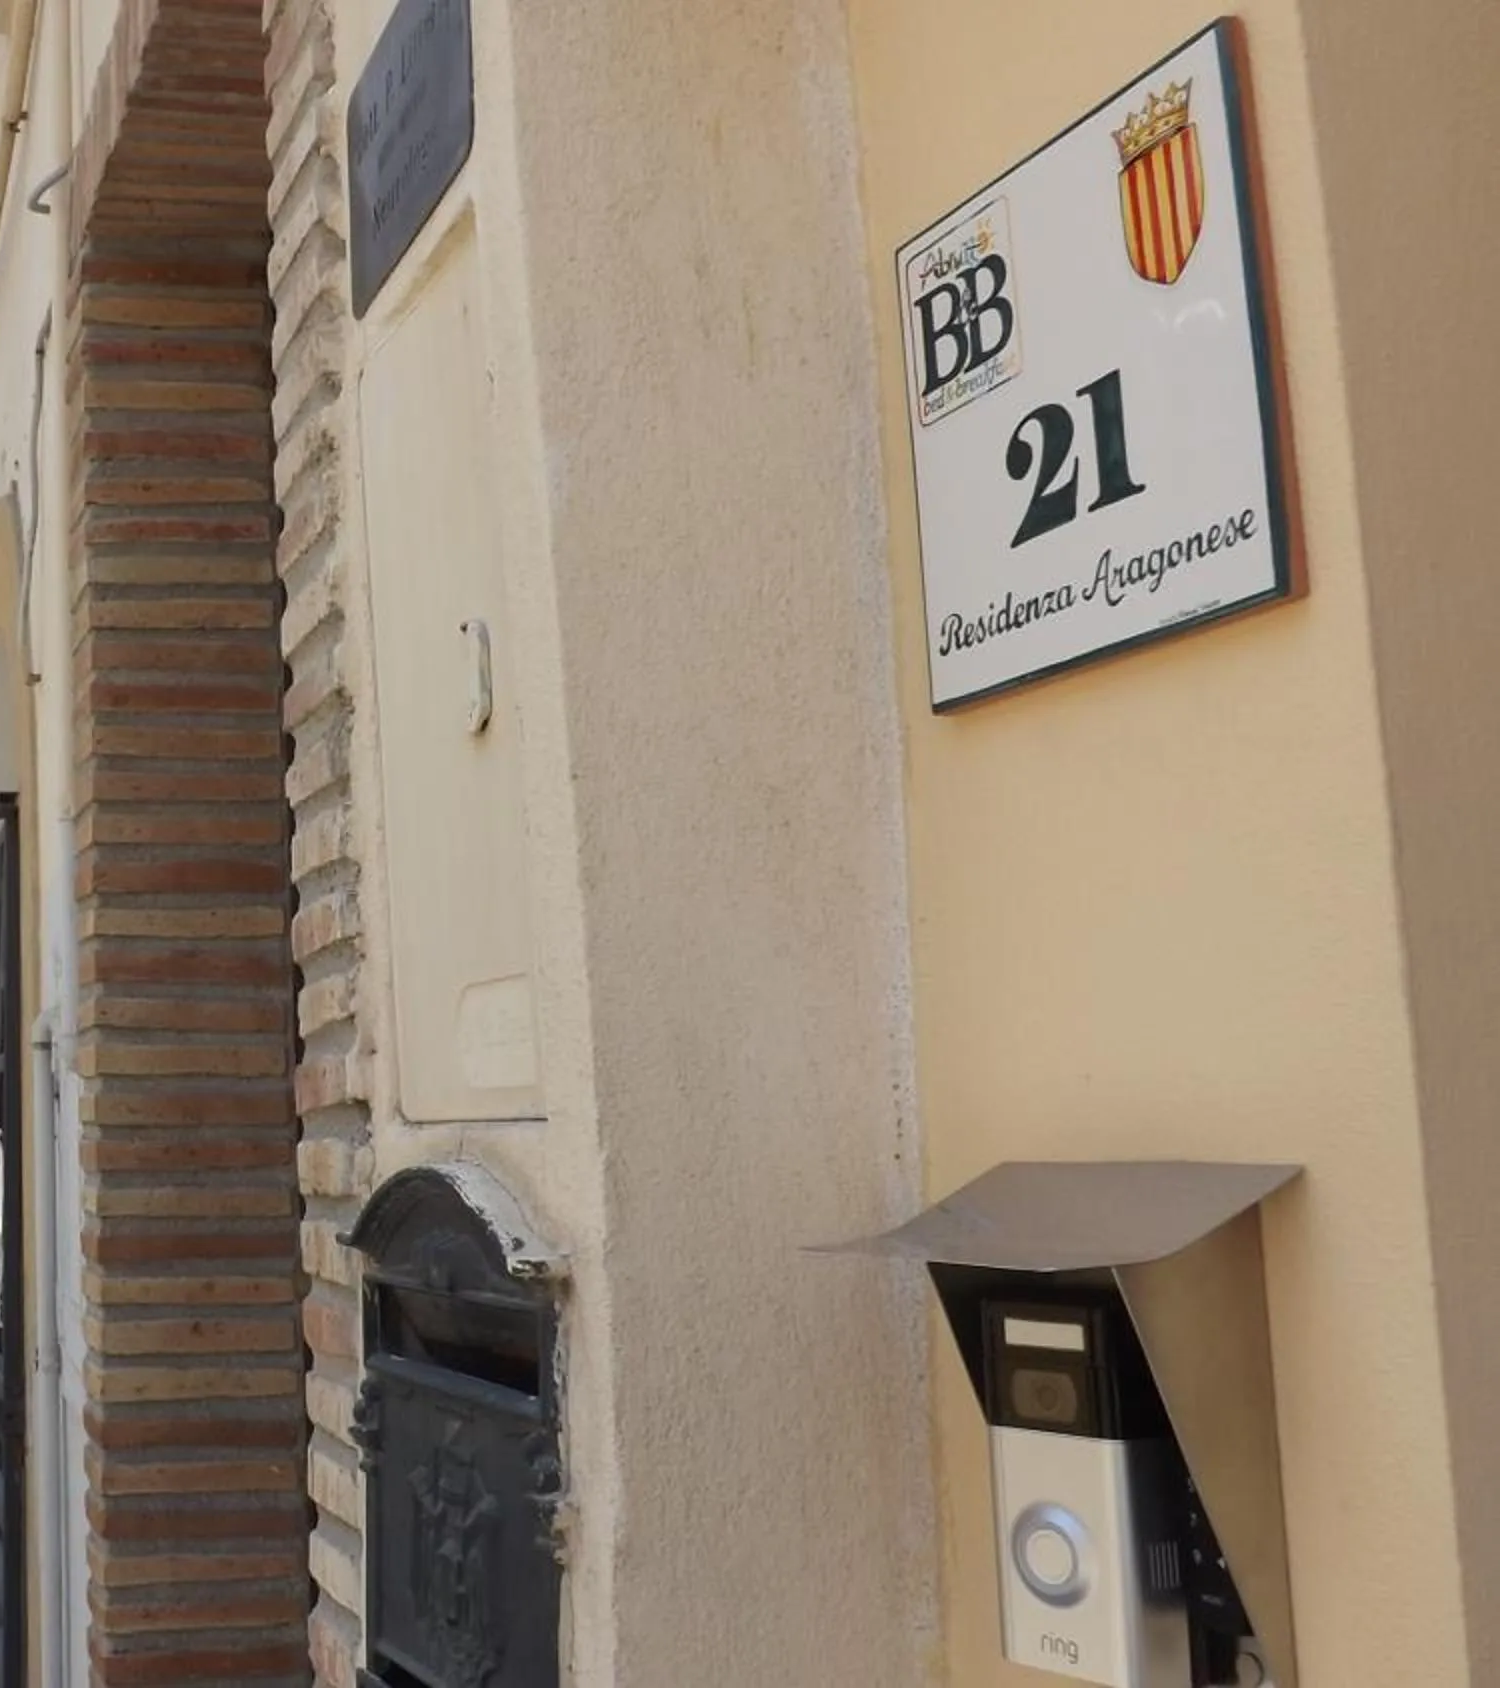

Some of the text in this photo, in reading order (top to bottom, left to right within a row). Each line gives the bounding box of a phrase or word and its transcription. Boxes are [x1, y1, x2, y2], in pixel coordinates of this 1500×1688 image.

[1005, 368, 1146, 549] 21
[939, 509, 1258, 657] Residenza Aragonese
[1041, 1631, 1079, 1665] ring
